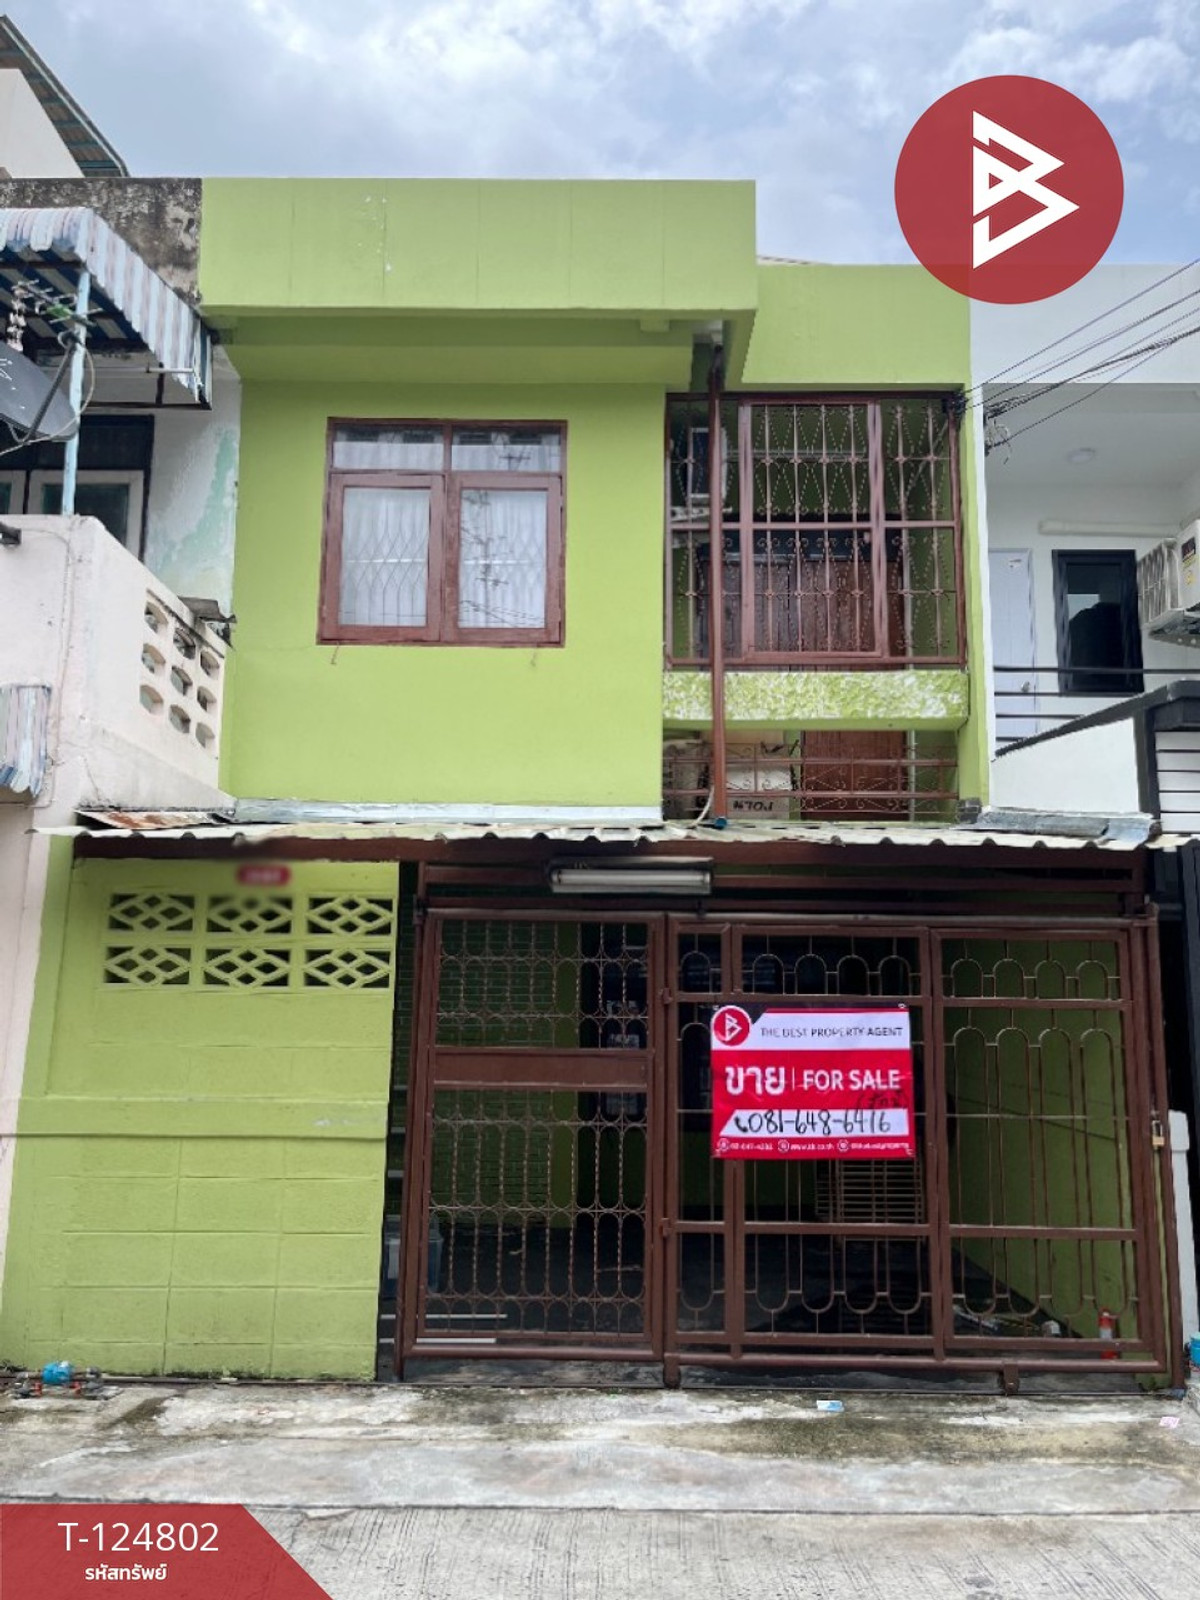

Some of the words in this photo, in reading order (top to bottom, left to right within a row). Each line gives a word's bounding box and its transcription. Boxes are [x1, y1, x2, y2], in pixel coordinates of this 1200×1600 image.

[761, 1027, 780, 1037] THE
[782, 1027, 807, 1037] BEST
[811, 1027, 865, 1037] PROPERTY
[867, 1027, 903, 1036] AGENT
[725, 1066, 785, 1096] ขาย
[803, 1069, 844, 1091] FOR
[849, 1069, 901, 1091] SALE
